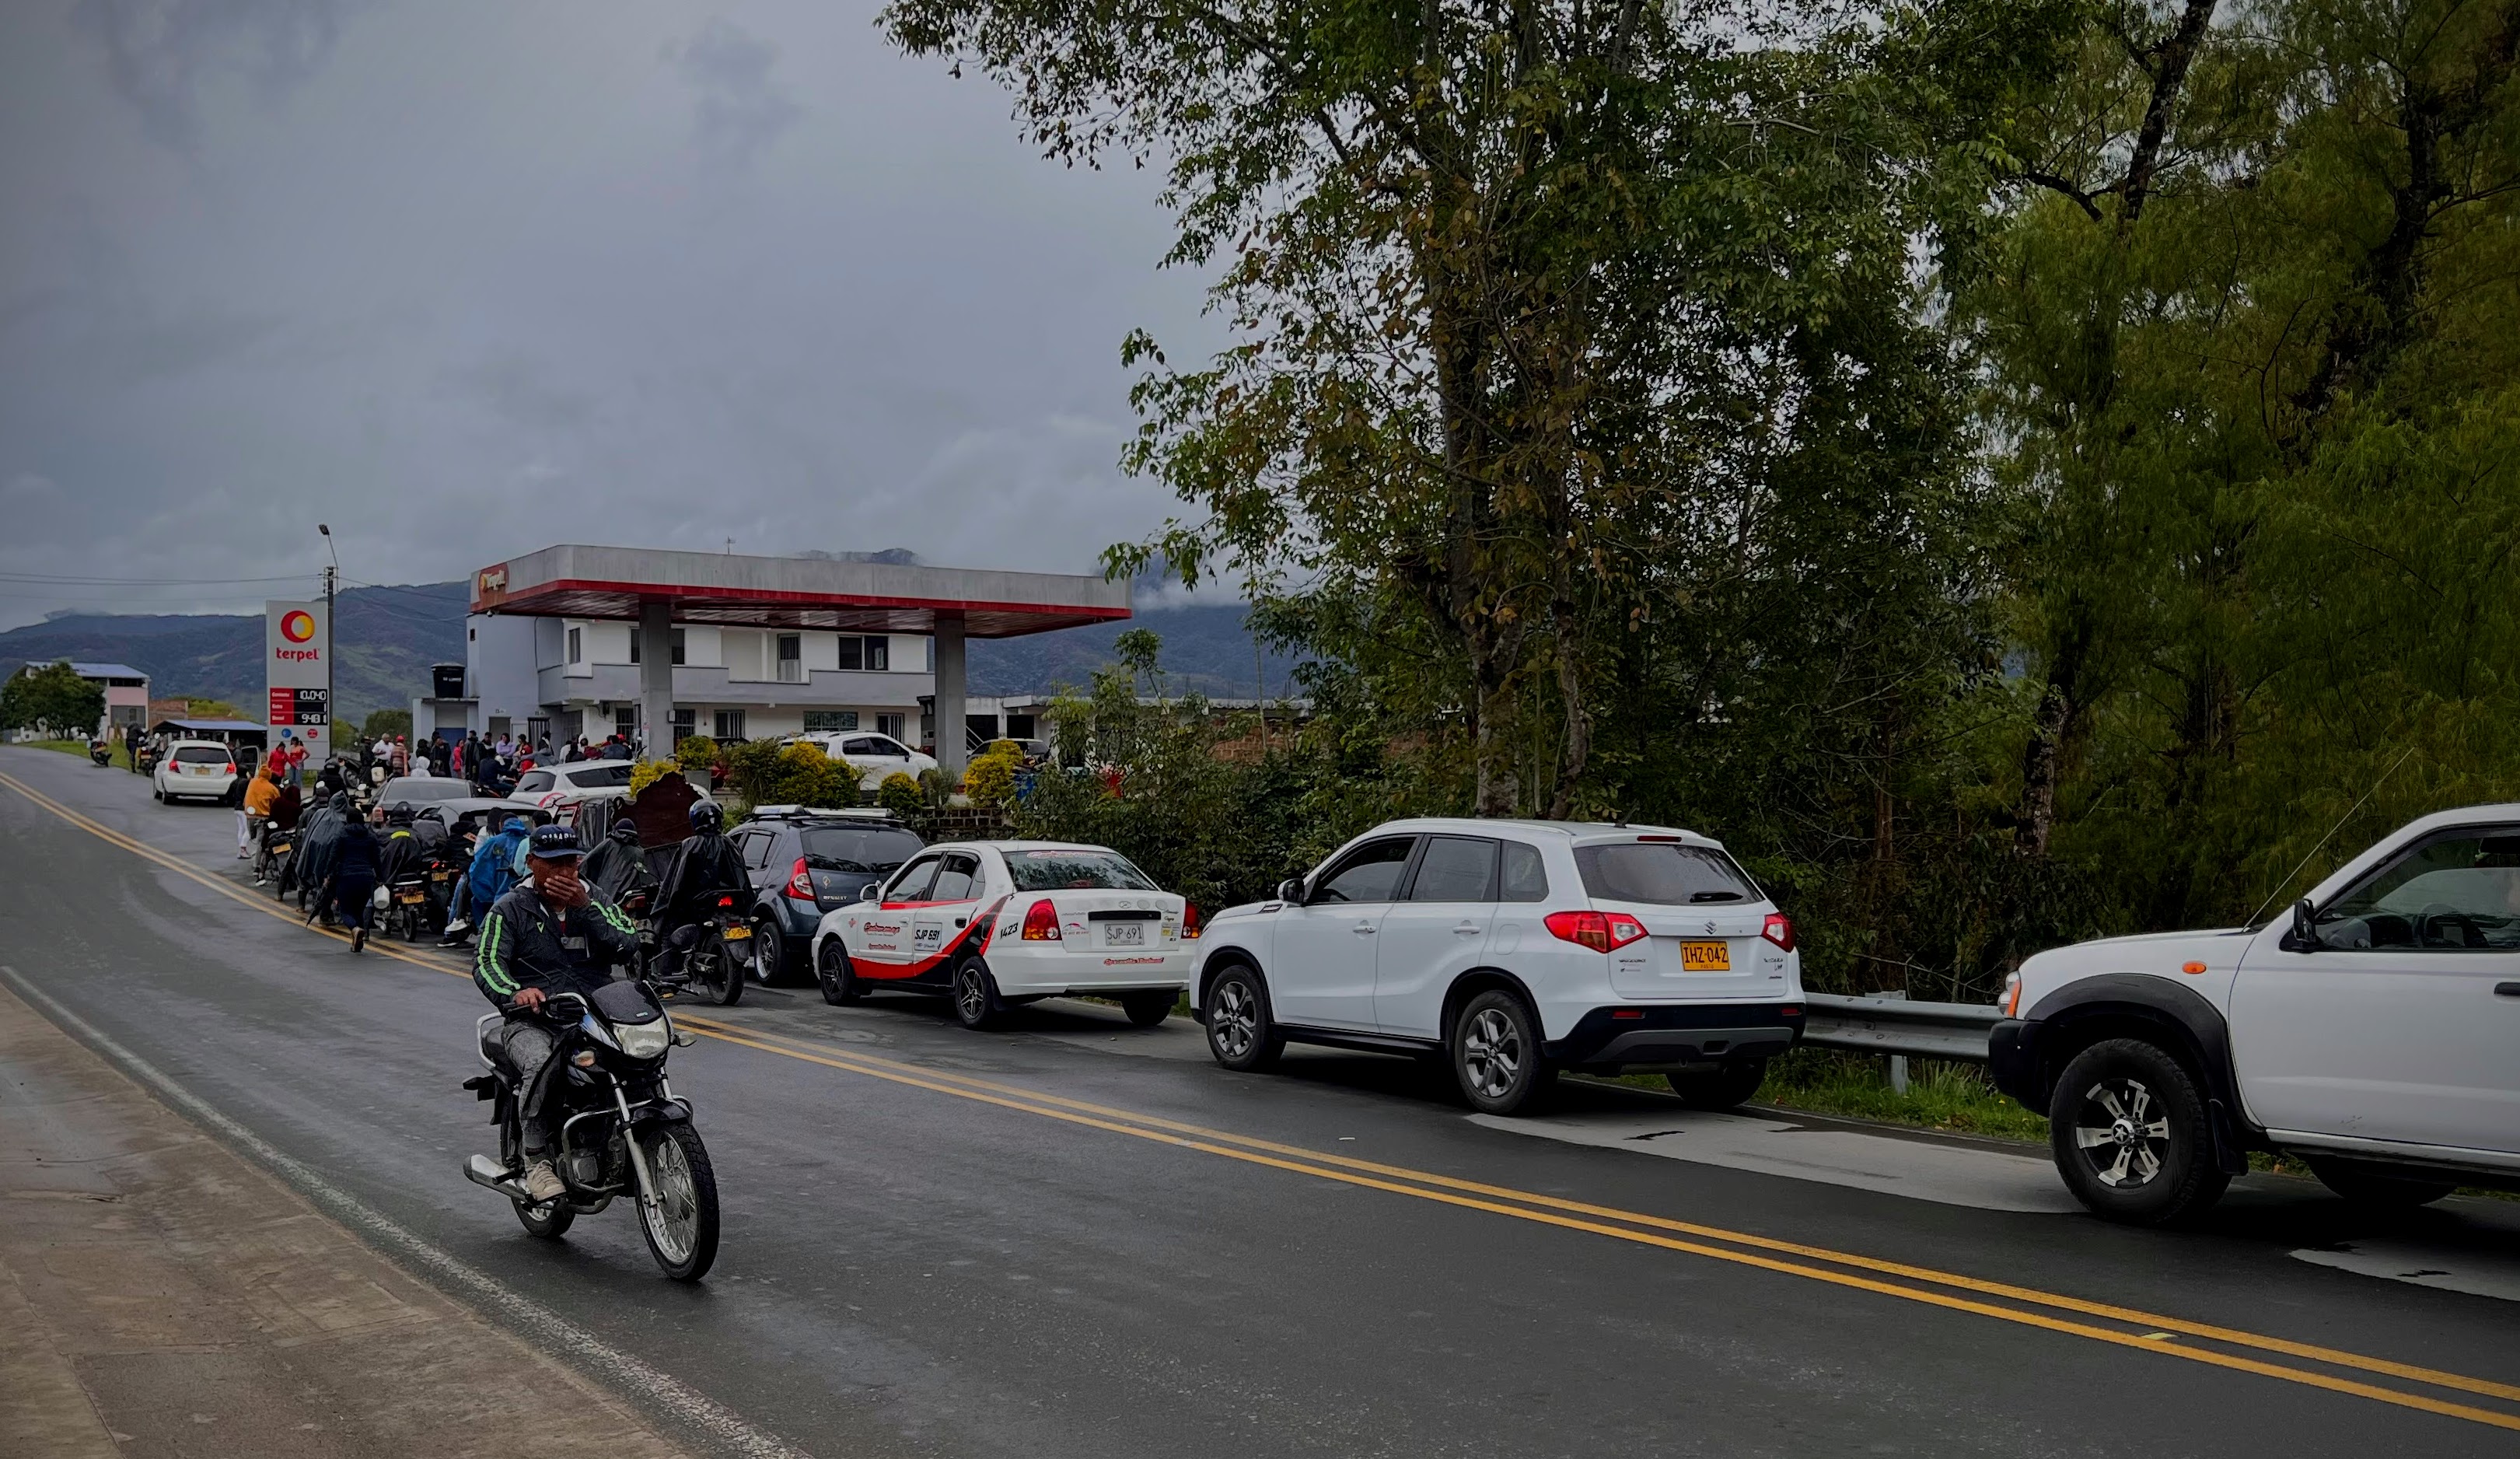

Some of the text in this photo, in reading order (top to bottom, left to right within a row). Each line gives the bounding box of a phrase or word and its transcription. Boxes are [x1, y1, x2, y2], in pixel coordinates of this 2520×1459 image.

[276, 647, 319, 662] terpel
[914, 929, 940, 940] SJP 691
[1000, 922, 1019, 939] 1423
[1106, 927, 1142, 939] SJP 691
[1683, 946, 1728, 963] IHZ 042
